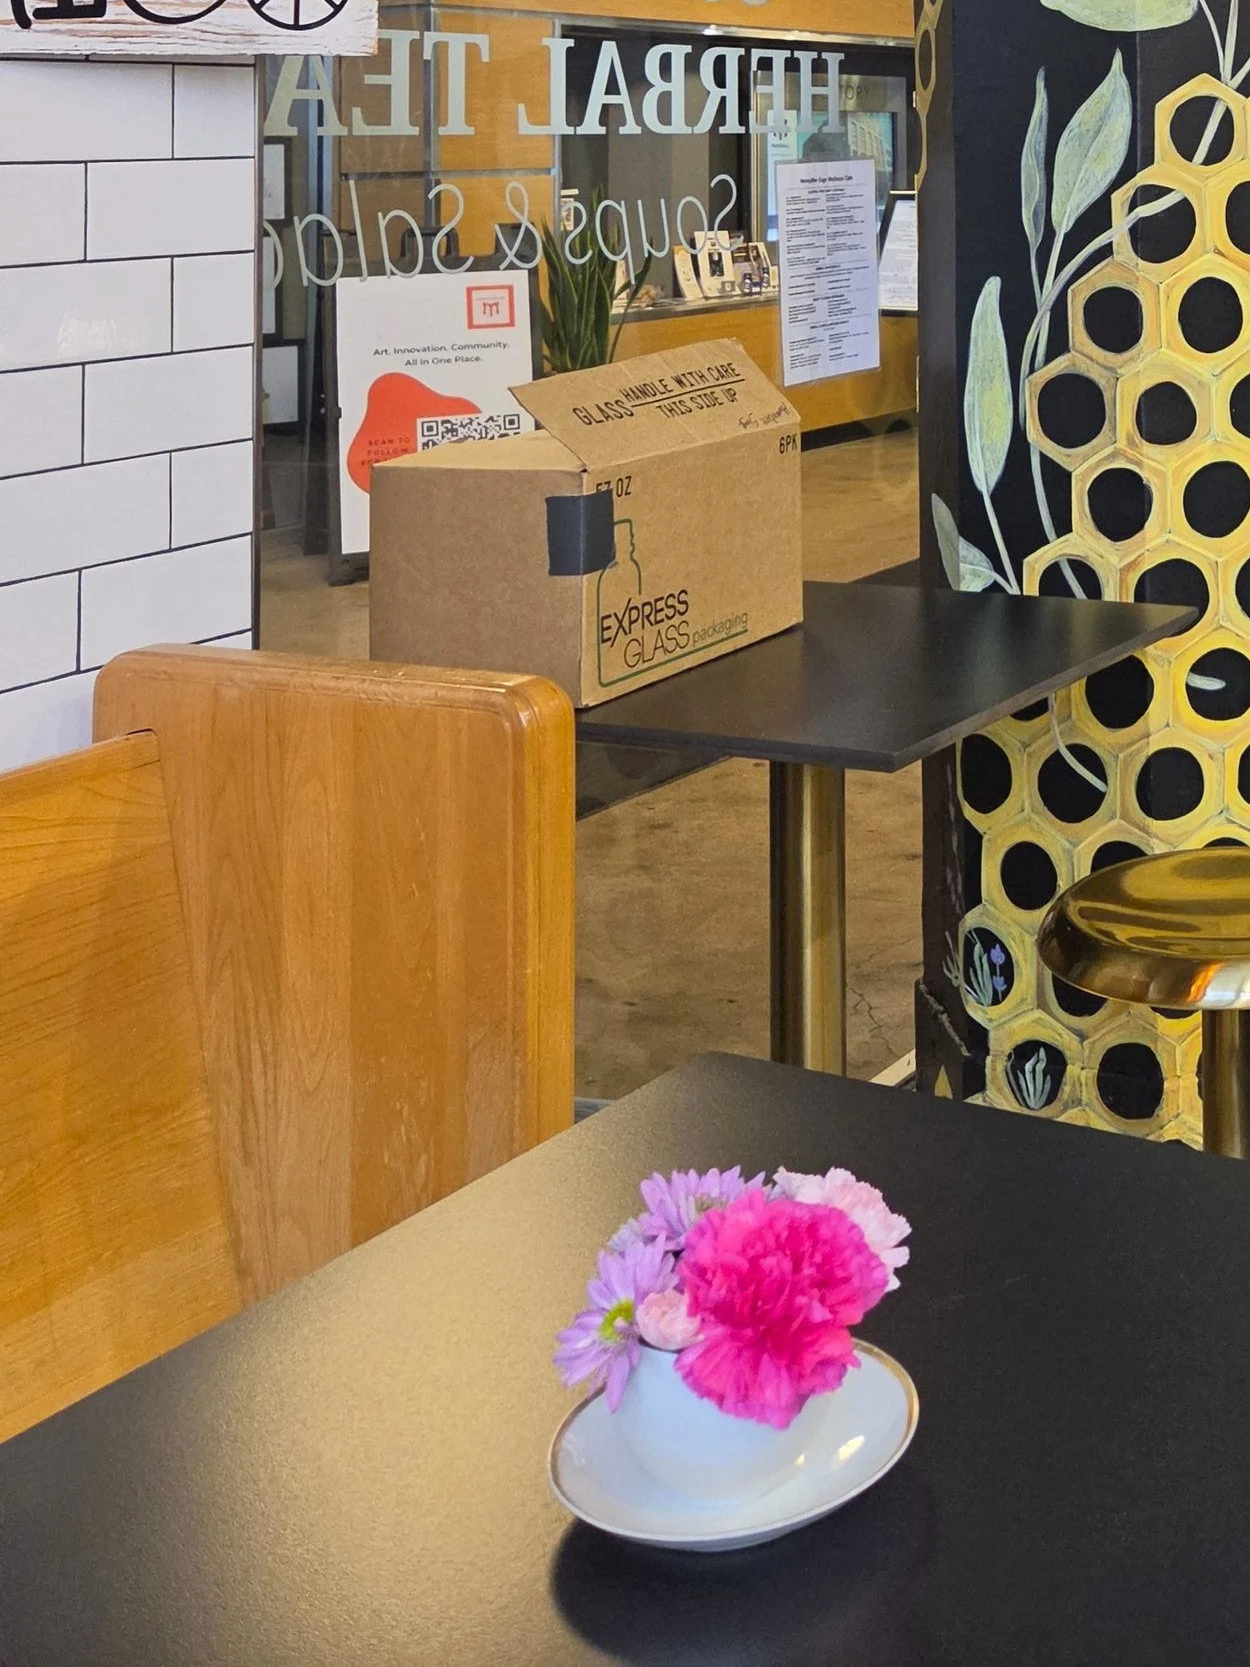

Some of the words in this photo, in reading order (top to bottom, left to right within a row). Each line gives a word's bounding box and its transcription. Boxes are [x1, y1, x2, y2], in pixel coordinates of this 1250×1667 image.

[373, 347, 391, 357] Art.
[393, 344, 449, 355] Innovation.
[451, 340, 509, 352] Community.
[405, 358, 418, 366] All
[431, 357, 452, 365] One
[454, 355, 483, 364] Place.
[619, 378, 673, 403] HANDLE
[671, 369, 711, 389] WITH
[707, 362, 741, 382] CARE
[572, 399, 635, 426] GLASS
[656, 400, 692, 419] THIS
[692, 391, 725, 410] SIDE
[724, 388, 738, 403] UP
[368, 437, 394, 447] SCAN
[398, 436, 411, 445] TO
[779, 433, 798, 454] 6PK
[600, 589, 689, 648] EXPRESS
[624, 620, 690, 669] GLASS
[692, 612, 749, 648] packaging
